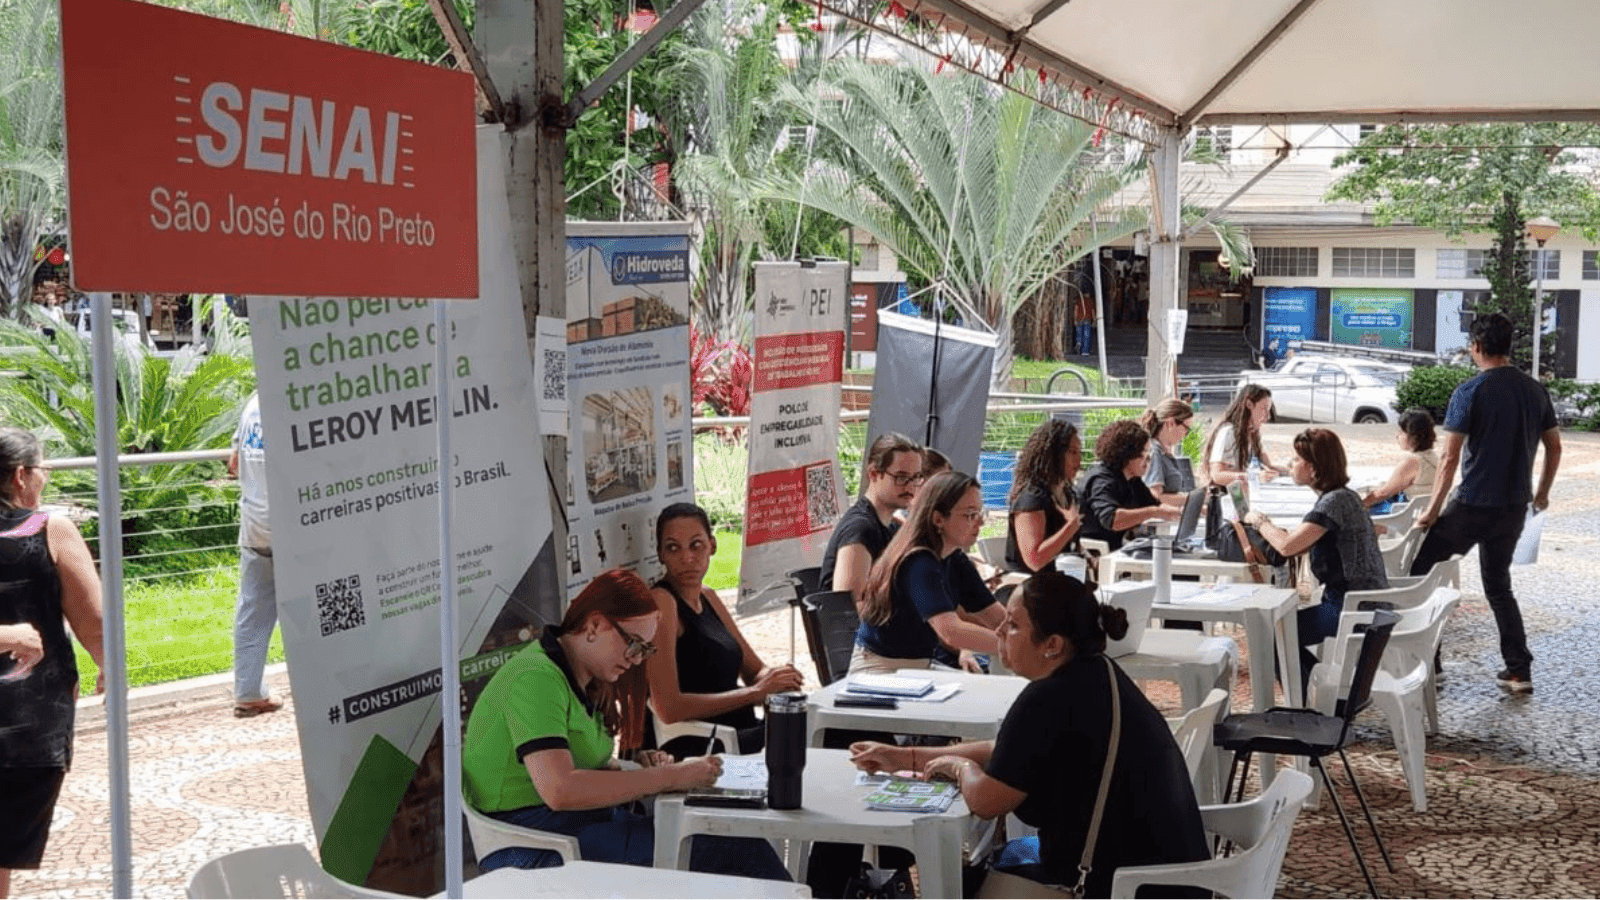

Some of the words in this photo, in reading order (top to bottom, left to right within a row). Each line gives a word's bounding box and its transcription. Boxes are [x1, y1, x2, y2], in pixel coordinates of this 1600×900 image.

[195, 81, 400, 186] SENAI
[149, 186, 210, 233] São
[220, 192, 286, 238] José
[293, 199, 325, 241] do
[332, 202, 372, 243] Rio
[378, 206, 436, 247] Preto
[627, 254, 685, 273] Hidroveda
[279, 296, 339, 330] Não
[810, 288, 832, 316] PEI
[284, 346, 301, 371] a
[309, 326, 419, 366] chance
[285, 362, 433, 411] trabalhar
[290, 406, 383, 454] LEROY
[389, 384, 500, 432] MELIN.
[297, 482, 322, 507] Há
[325, 476, 364, 499] anos
[299, 497, 373, 527] carreiras
[463, 460, 512, 486] Brasil.
[462, 650, 514, 677] carreir
[349, 672, 443, 717] CONSTRUIMO
